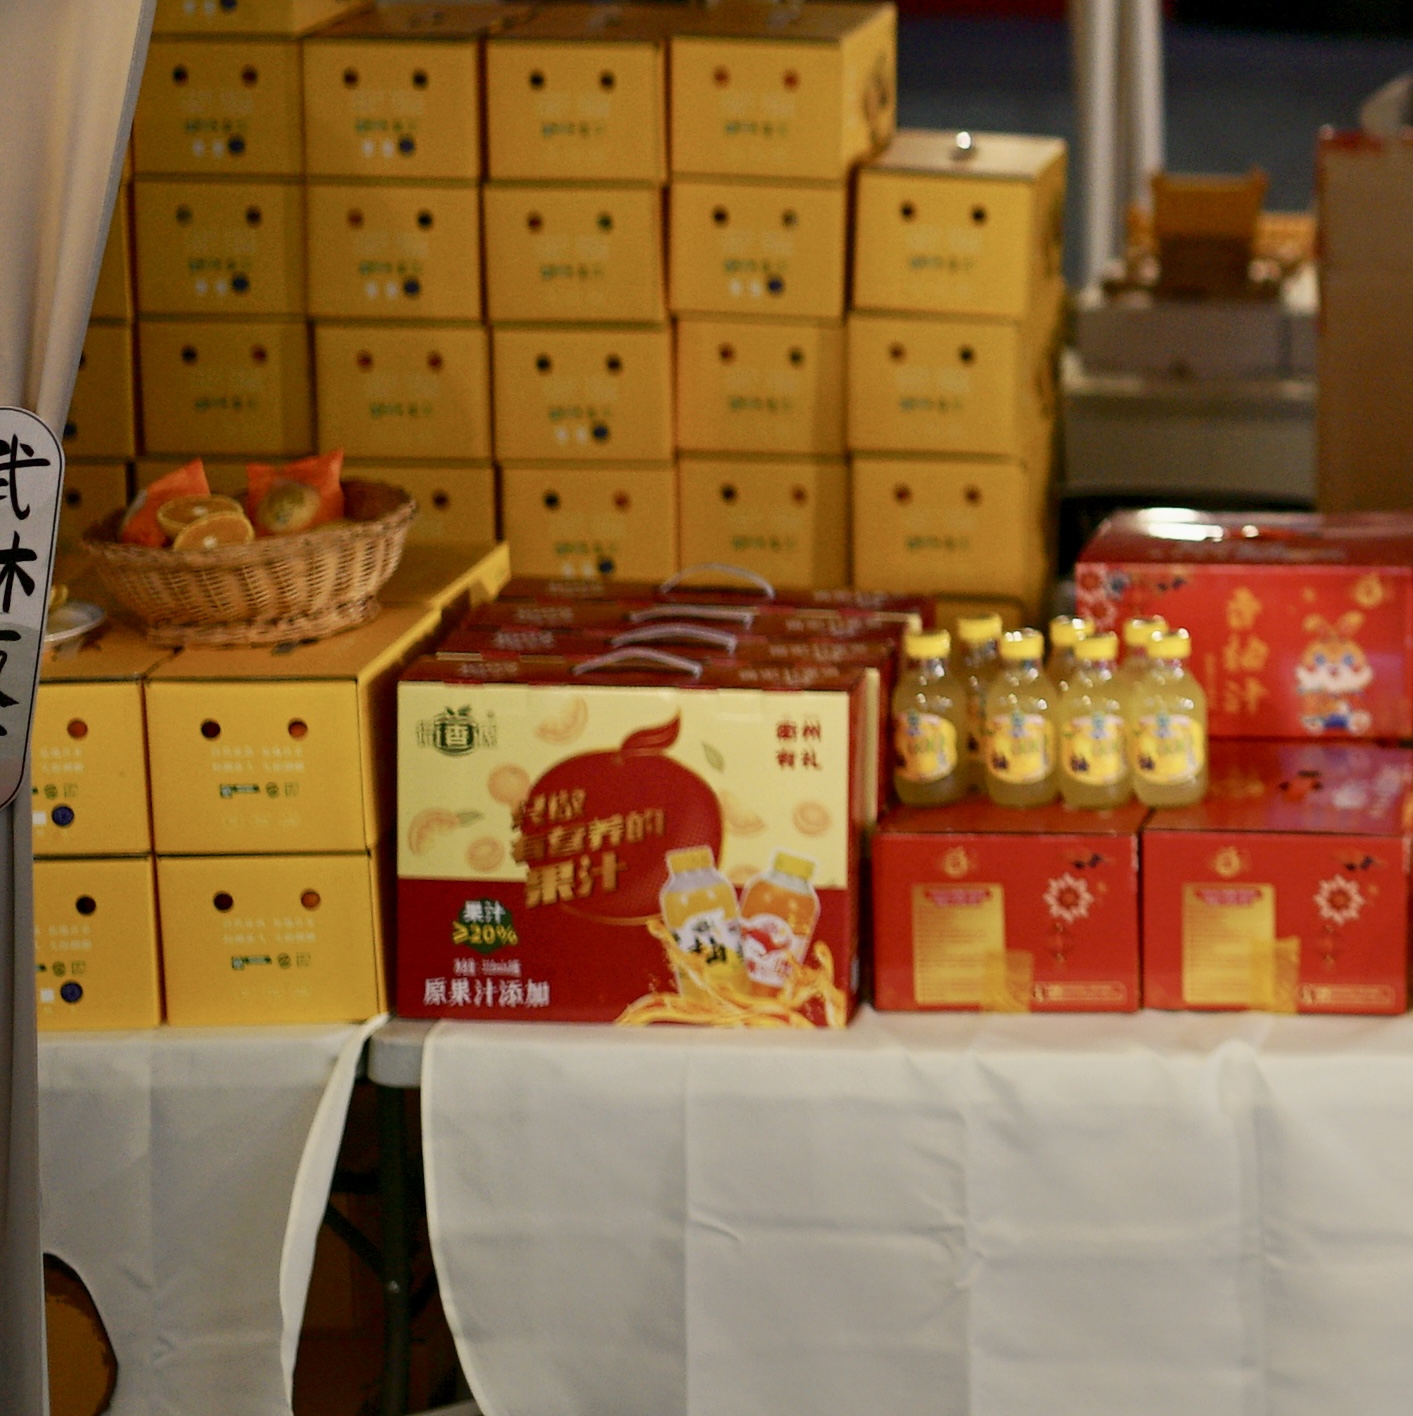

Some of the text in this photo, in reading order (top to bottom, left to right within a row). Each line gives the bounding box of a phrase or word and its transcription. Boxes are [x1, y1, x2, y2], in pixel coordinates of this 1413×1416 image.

[511, 808, 666, 864] 有营养的
[525, 850, 629, 909] 果汁
[463, 900, 506, 923] 果汁
[423, 977, 550, 1008] 原果汁添加
